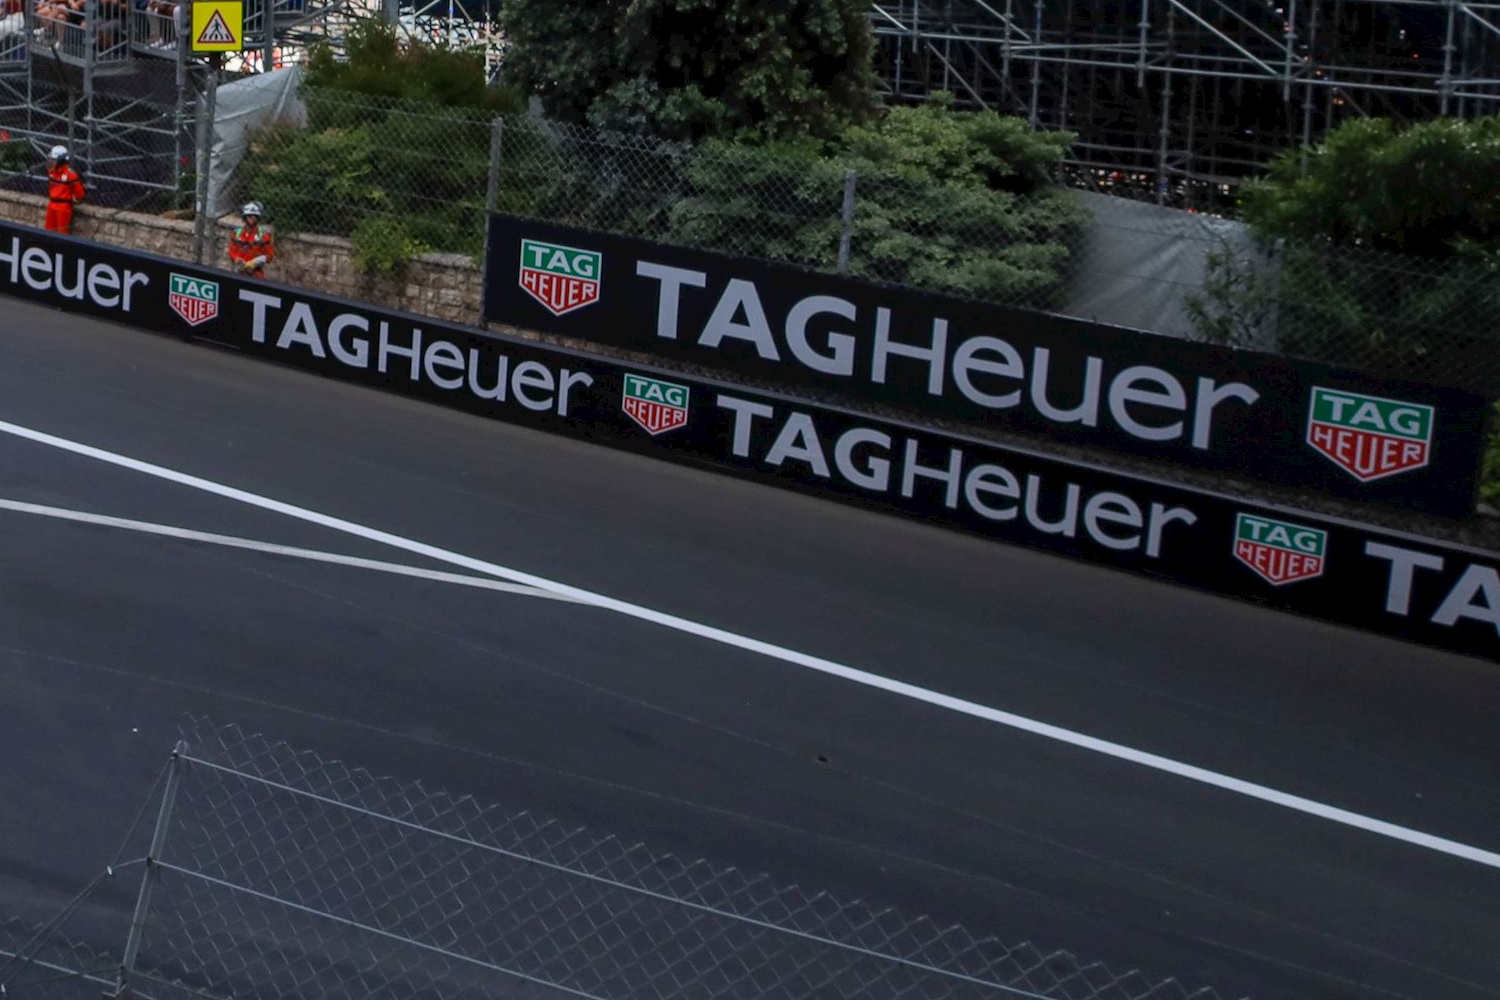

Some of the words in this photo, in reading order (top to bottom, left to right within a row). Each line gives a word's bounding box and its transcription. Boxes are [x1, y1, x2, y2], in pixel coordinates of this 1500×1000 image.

[527, 245, 593, 277] TAG
[173, 277, 215, 300] TAG
[523, 270, 595, 310] HEUER
[171, 295, 215, 322] HEUER
[629, 378, 683, 406] TAG
[625, 399, 684, 431] HEUER
[1321, 394, 1421, 436] TAG
[1314, 426, 1422, 475] HEUER
[1245, 519, 1318, 552] TAG
[1239, 543, 1319, 580] HEUER
